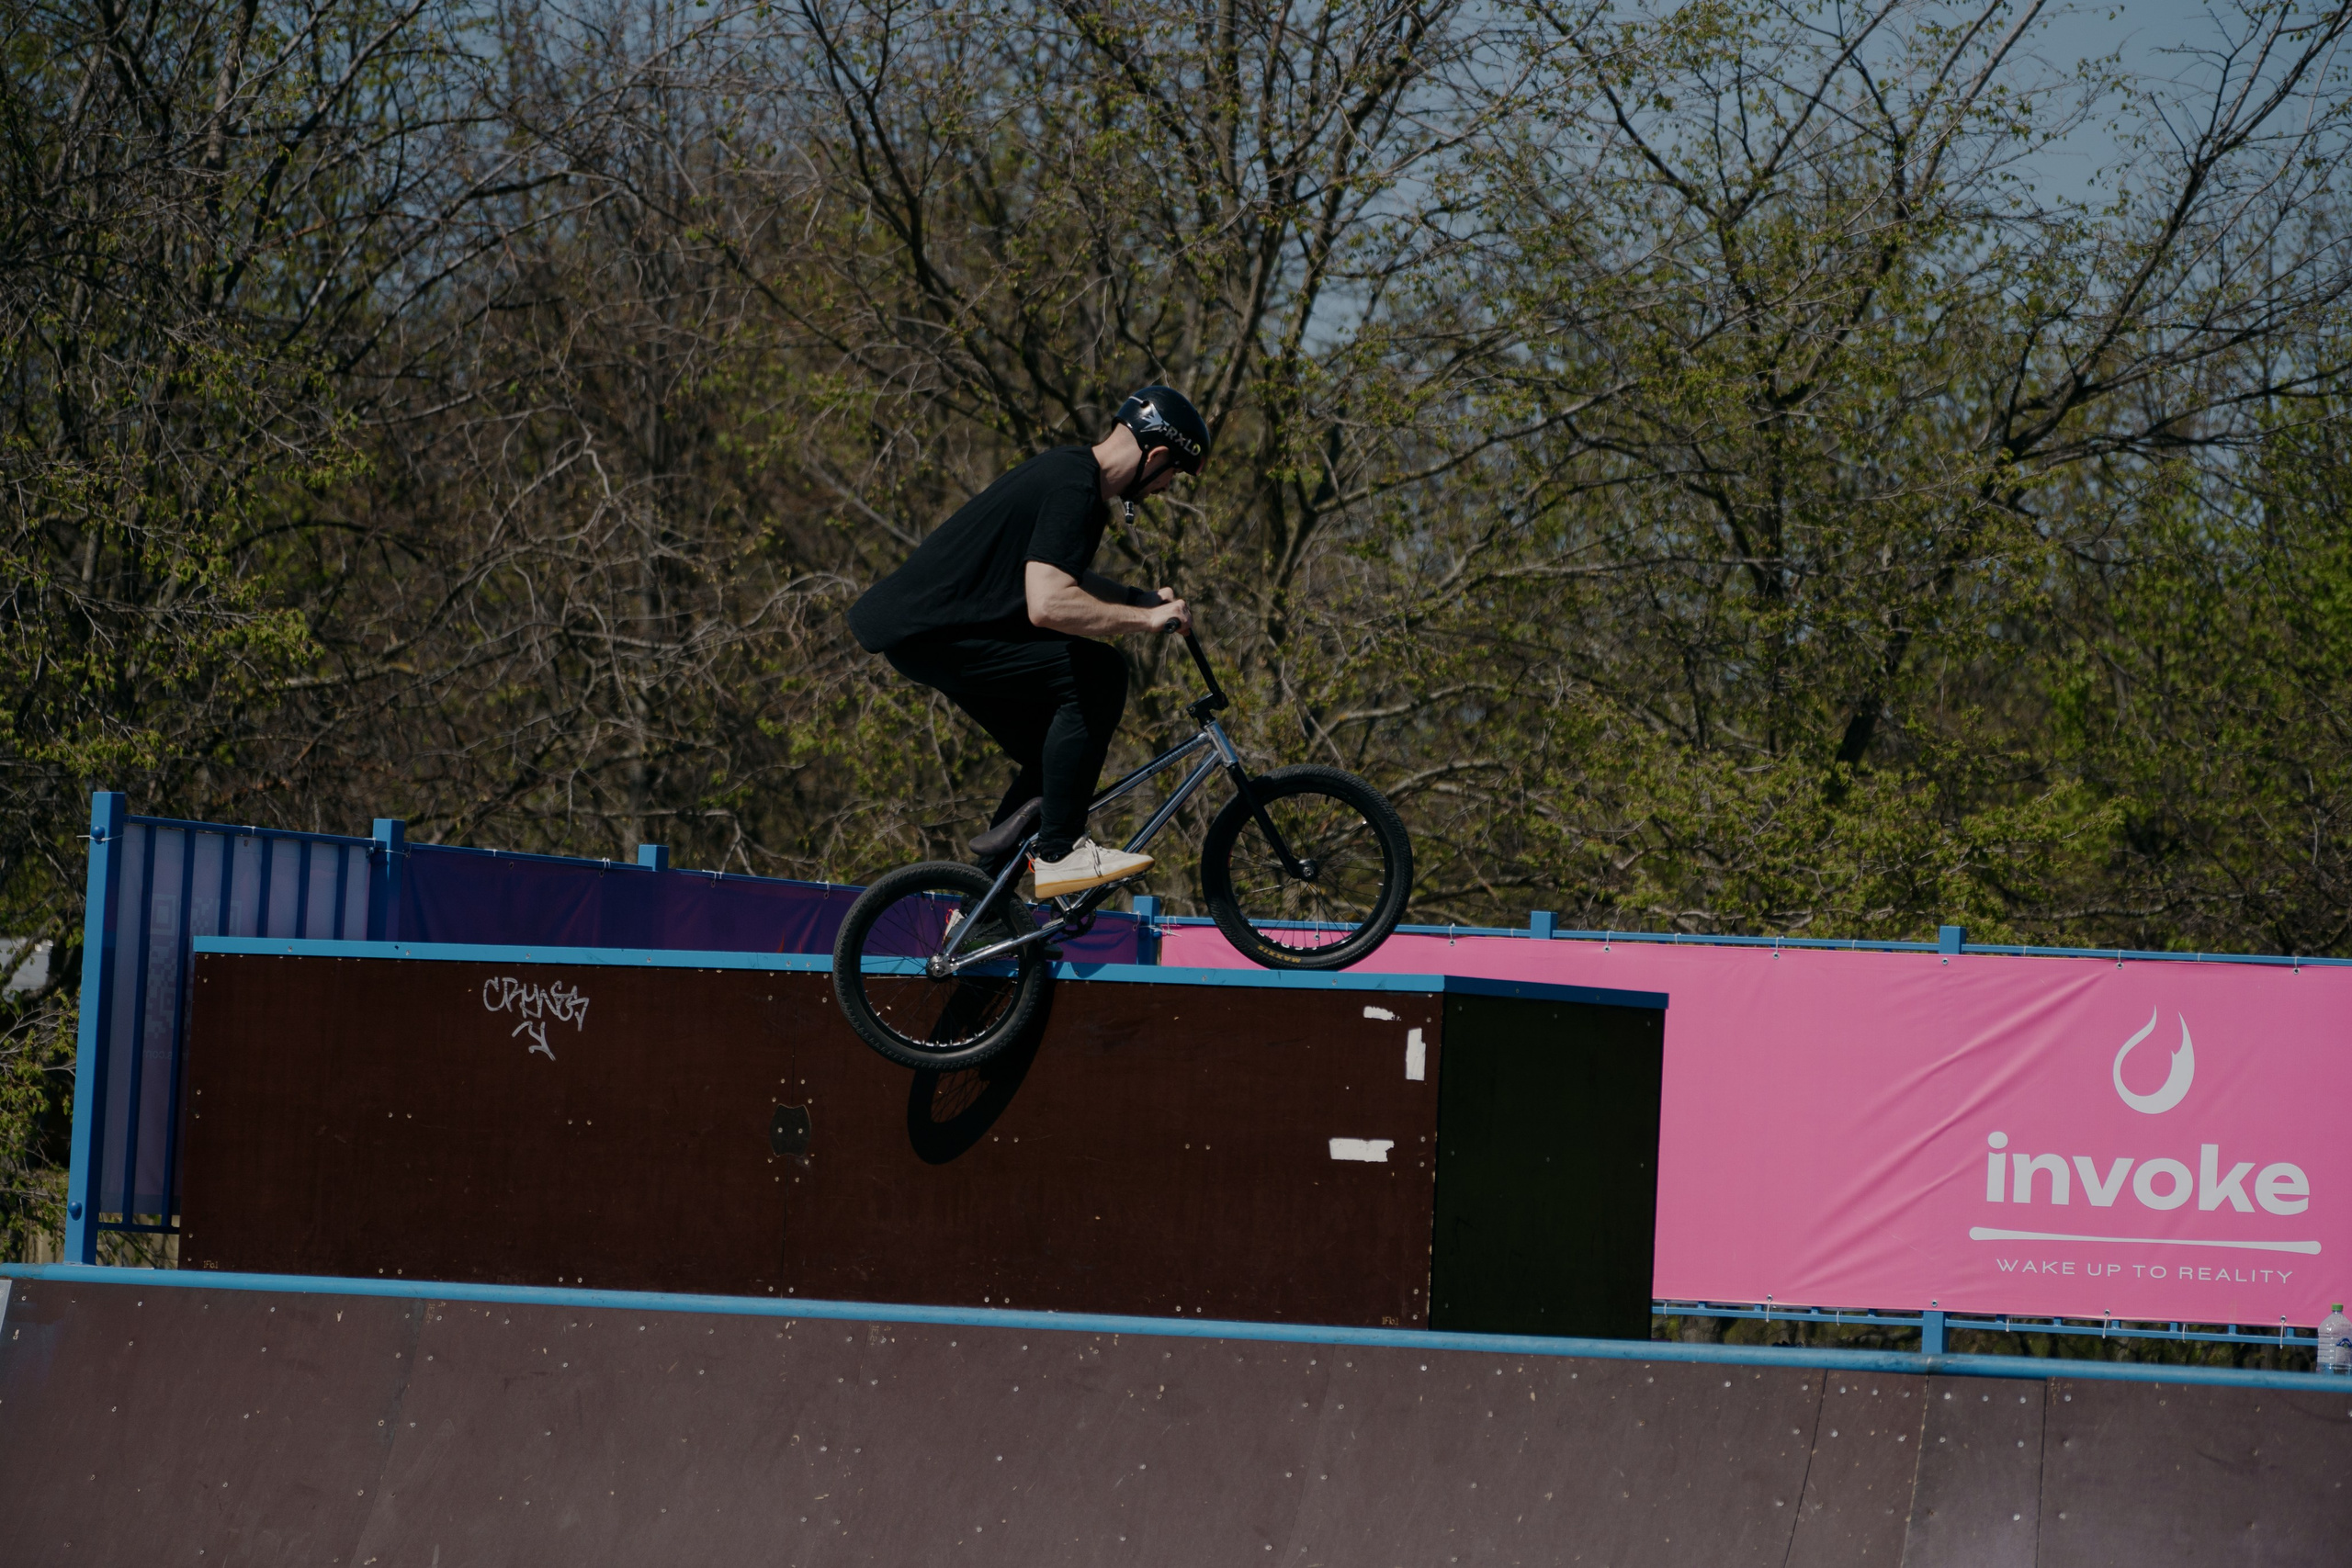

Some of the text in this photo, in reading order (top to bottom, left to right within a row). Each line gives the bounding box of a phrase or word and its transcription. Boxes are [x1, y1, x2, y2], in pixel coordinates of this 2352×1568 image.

[1986, 1131, 2311, 1216] invoke
[1996, 1258, 2293, 1284] WAKE UP TO REALITY
